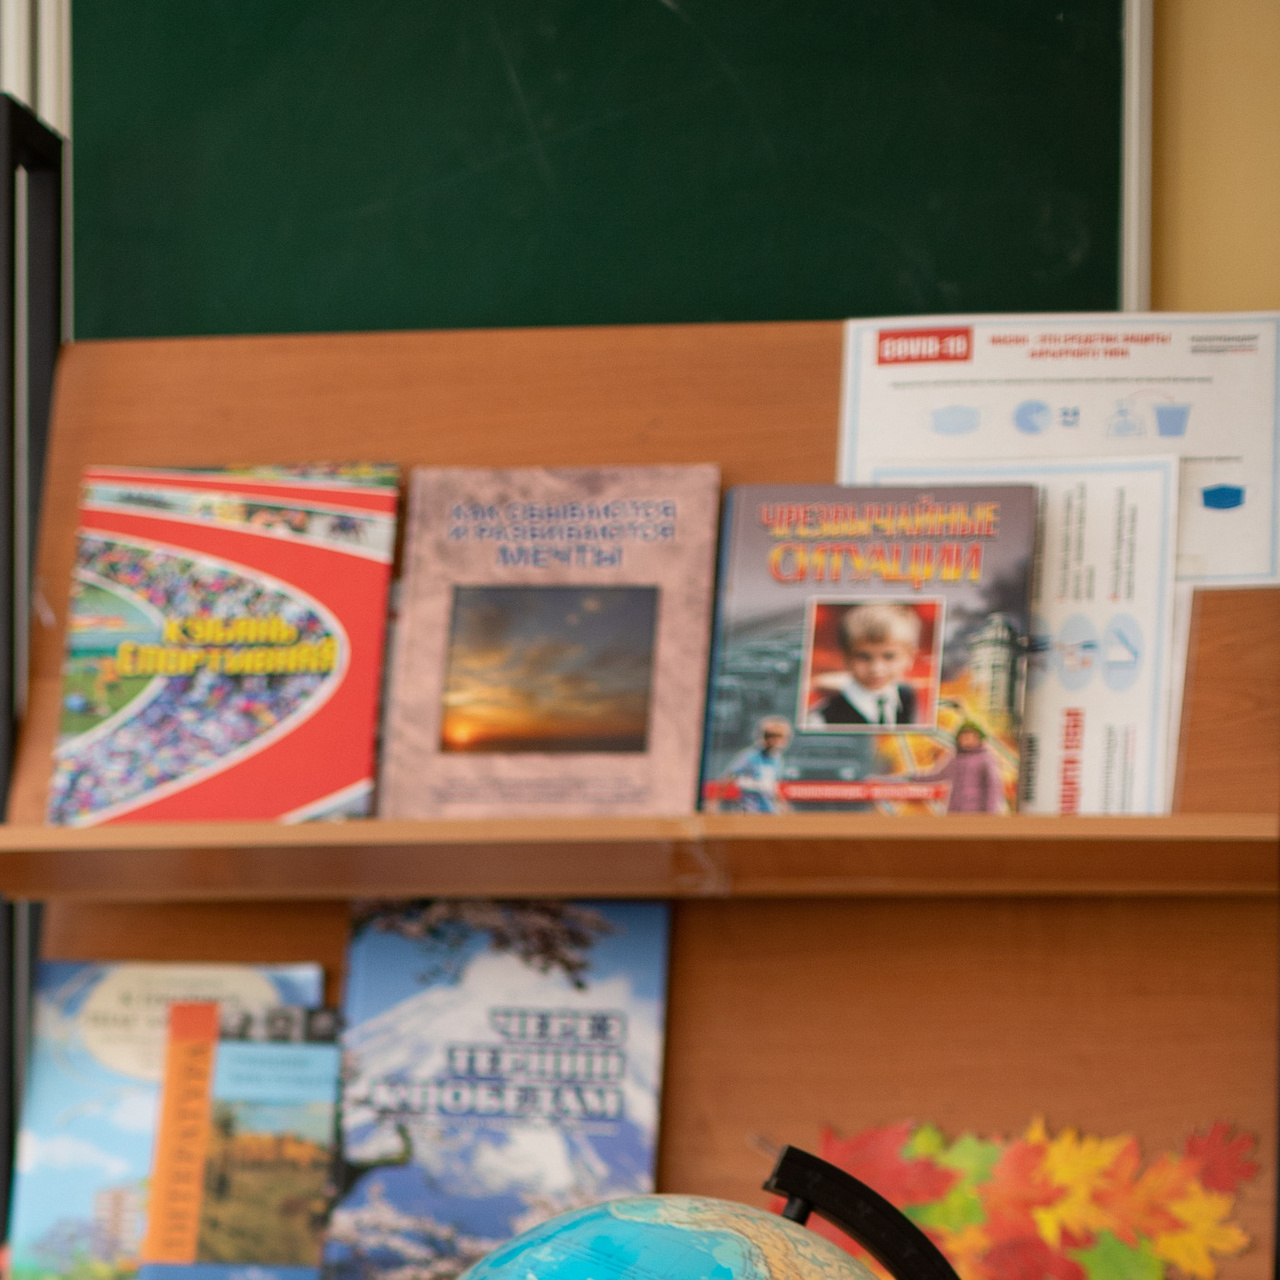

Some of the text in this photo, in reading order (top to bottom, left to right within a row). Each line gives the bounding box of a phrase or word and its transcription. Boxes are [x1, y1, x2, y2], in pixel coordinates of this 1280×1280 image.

[504, 498, 677, 522] СБЫВАЮТСЯ
[759, 493, 1001, 541] ЧРЕЗВЫЧАЙНЫЕ
[495, 544, 624, 569] МЕЧТЫ
[767, 541, 984, 589] СИТУАЦИИ
[412, 1083, 624, 1119] ПОБЕДАМ
